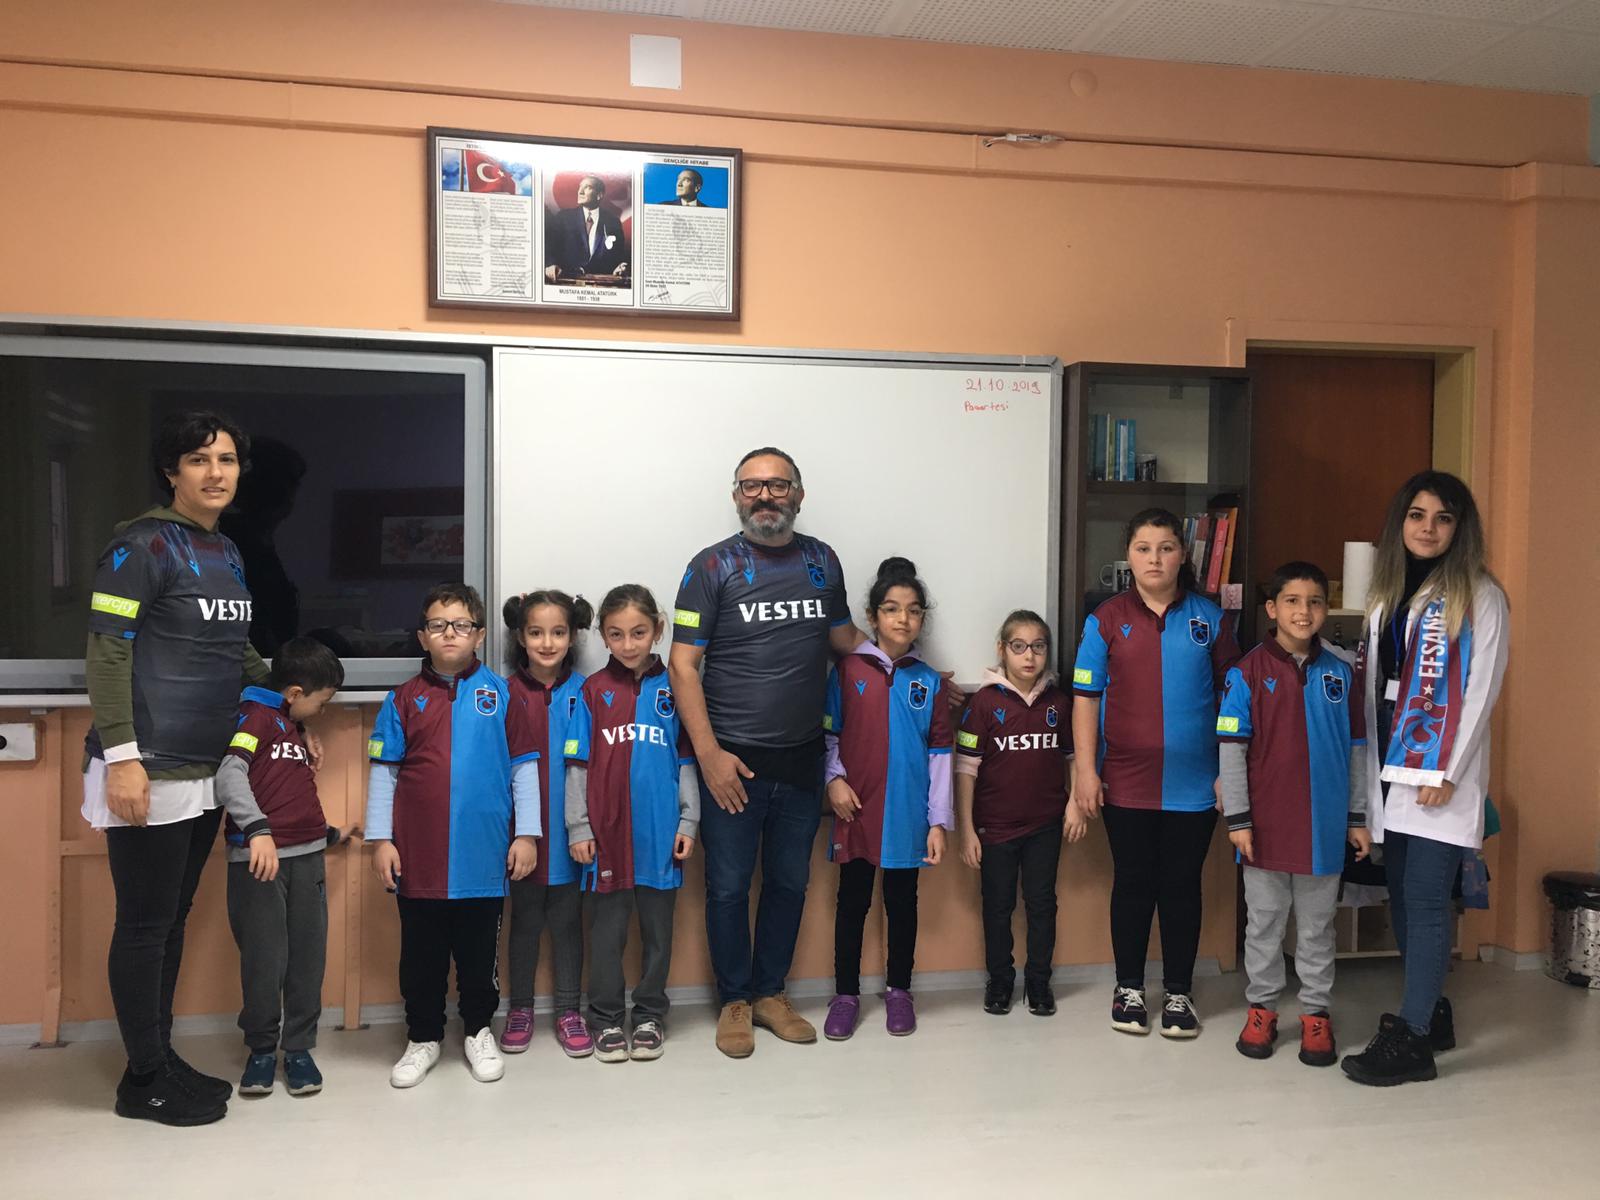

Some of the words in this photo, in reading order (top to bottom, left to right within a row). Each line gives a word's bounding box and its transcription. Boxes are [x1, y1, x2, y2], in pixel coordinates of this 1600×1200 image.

[738, 599, 826, 622] VESTEL
[602, 723, 667, 746] VESTEL
[993, 733, 1059, 751] VESTEL
